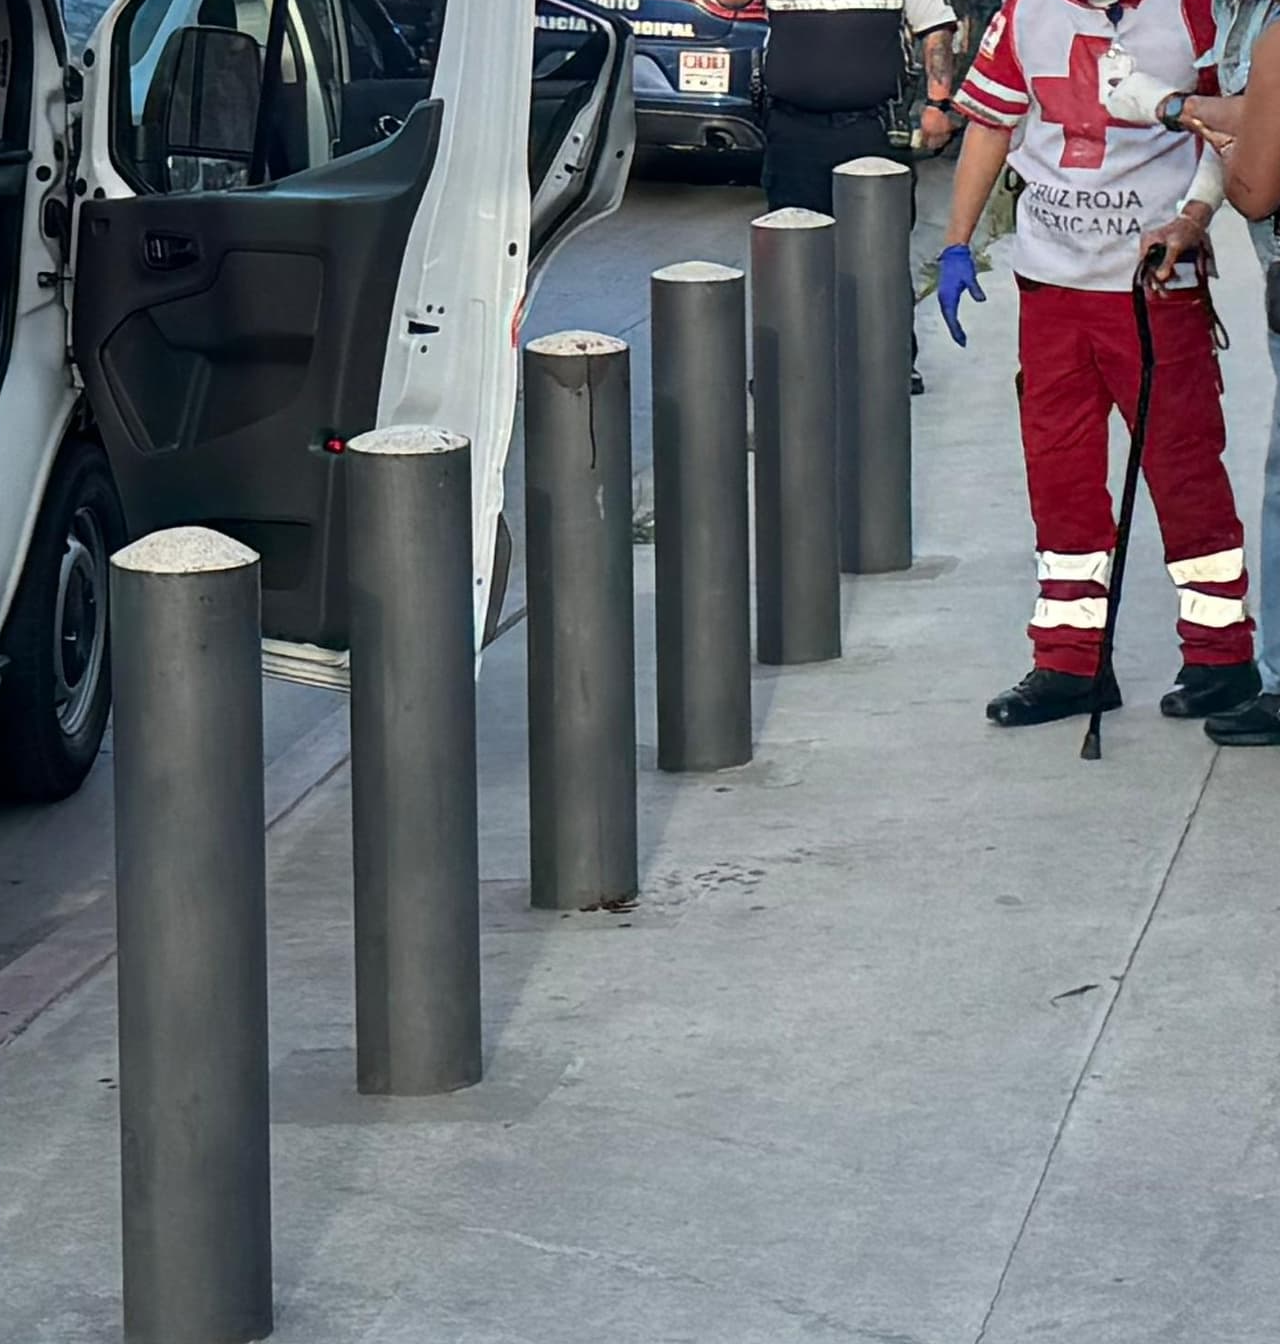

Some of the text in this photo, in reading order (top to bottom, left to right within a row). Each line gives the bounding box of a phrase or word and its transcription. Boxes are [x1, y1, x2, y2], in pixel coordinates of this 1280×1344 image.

[1026, 181, 1143, 209] CRUZ ROJA
[1029, 205, 1142, 236] MEXICANA
